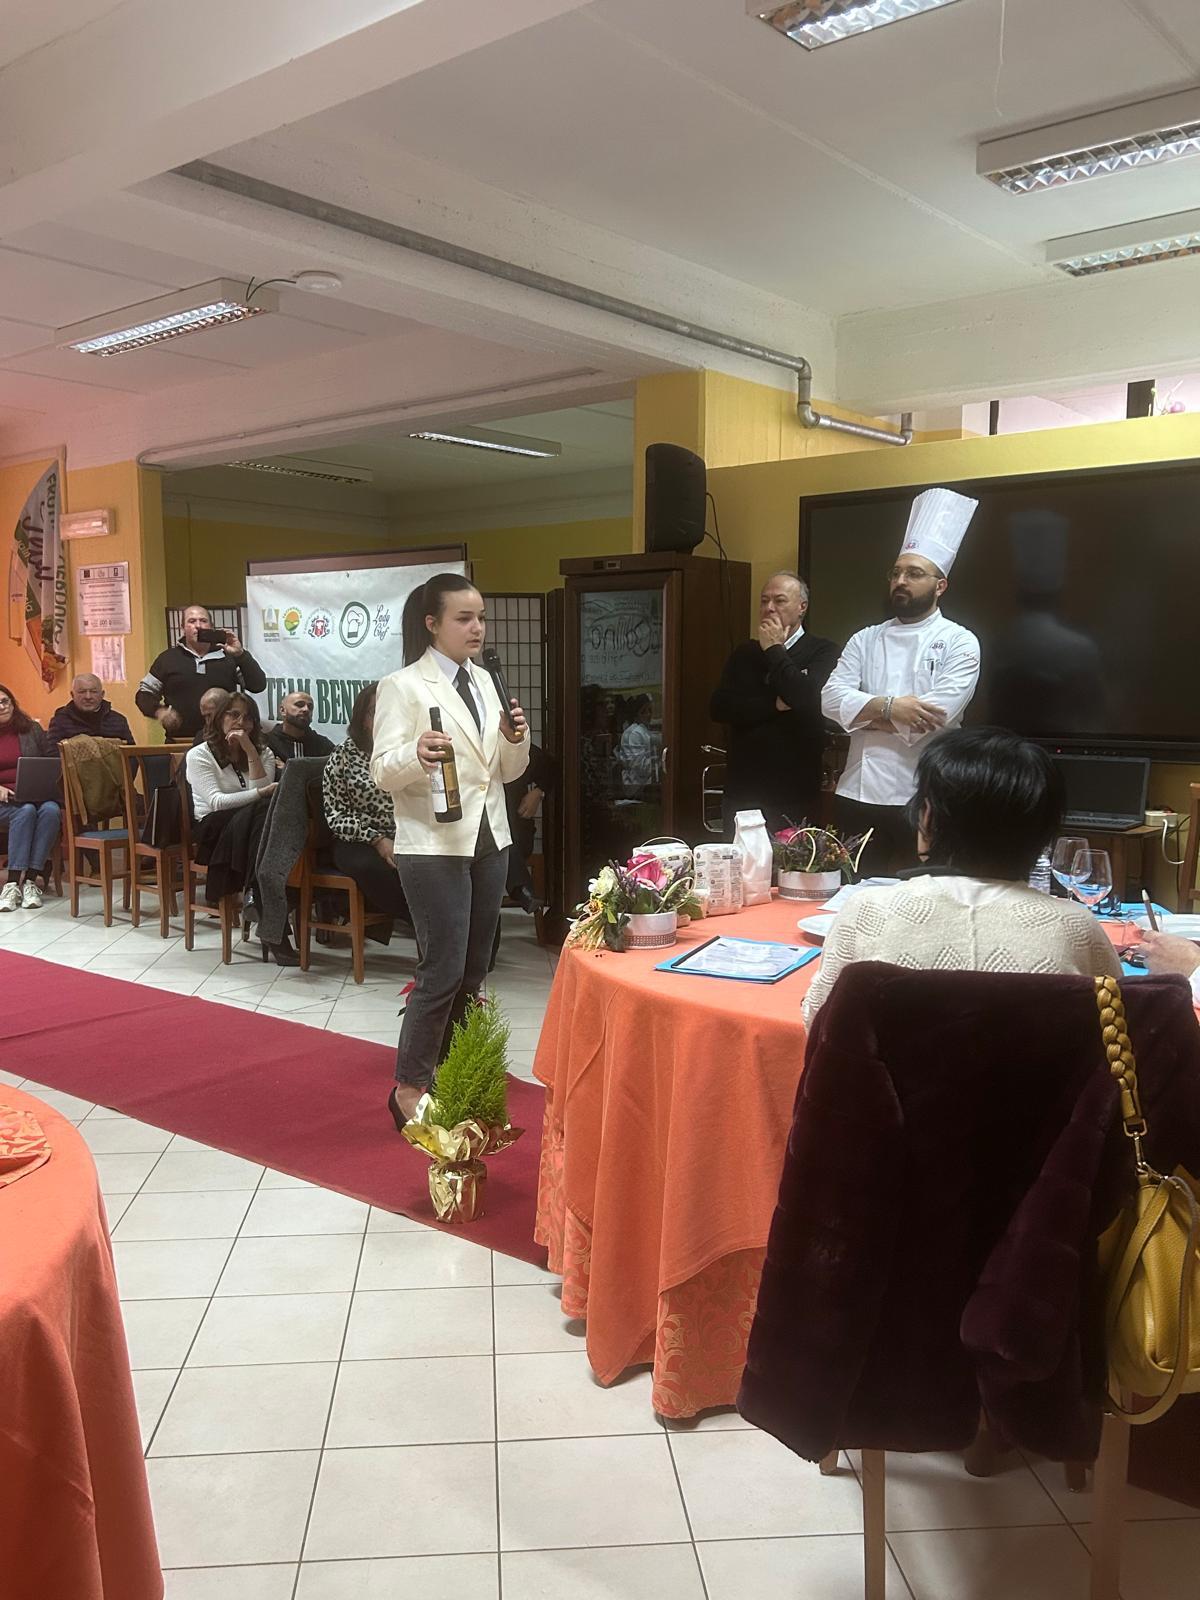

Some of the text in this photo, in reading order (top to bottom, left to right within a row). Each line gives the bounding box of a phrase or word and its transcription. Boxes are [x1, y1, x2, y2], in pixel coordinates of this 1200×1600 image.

[373, 604, 390, 627] Lady
[374, 623, 390, 641] Chef
[316, 678, 381, 725] BEN
